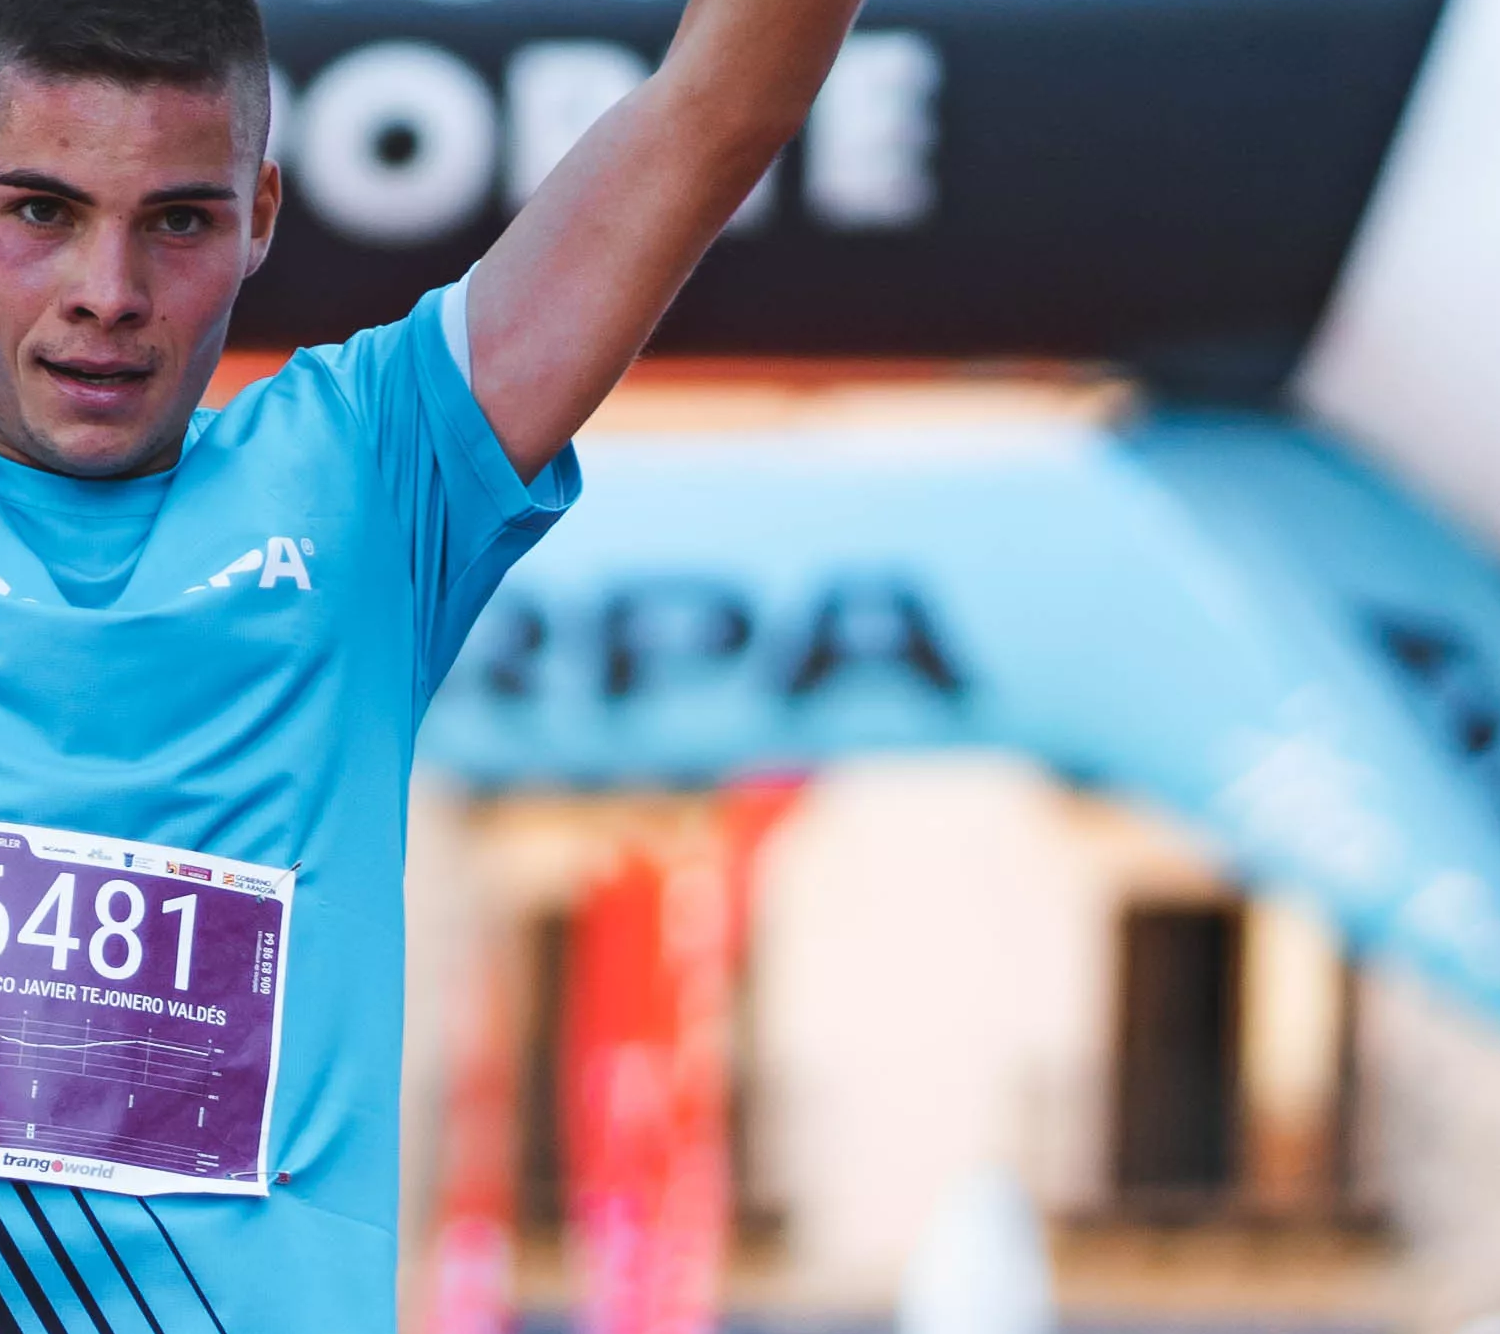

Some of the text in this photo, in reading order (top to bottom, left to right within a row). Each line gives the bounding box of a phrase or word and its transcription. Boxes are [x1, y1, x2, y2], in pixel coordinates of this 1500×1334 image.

[260, 932, 275, 995] 606 83 98 64
[19, 978, 77, 1002] JAVIER
[80, 985, 164, 1015] TEJONERO
[167, 999, 227, 1027] VALDÉS
